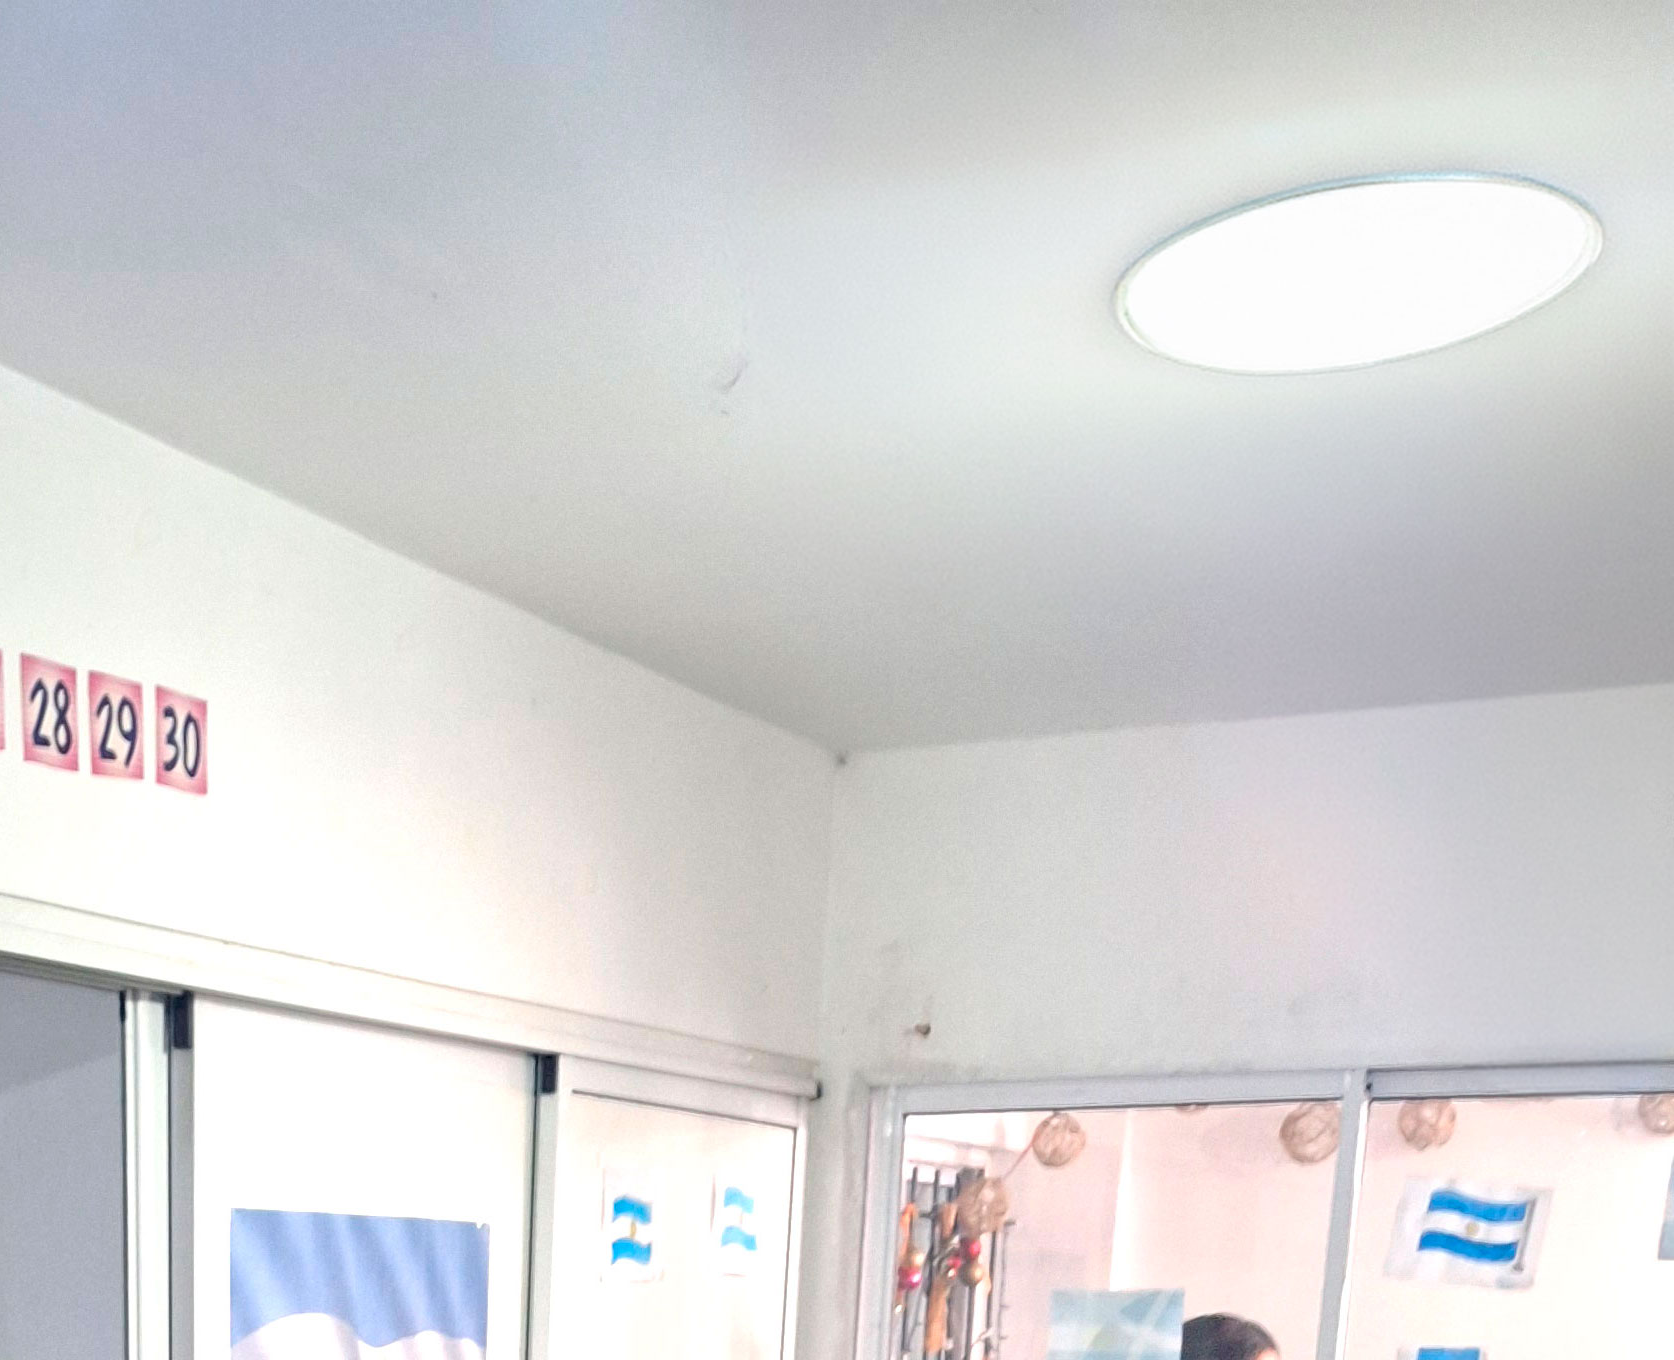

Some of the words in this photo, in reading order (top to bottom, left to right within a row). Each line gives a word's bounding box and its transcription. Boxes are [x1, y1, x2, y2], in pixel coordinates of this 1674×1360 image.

[30, 679, 72, 755] 28
[96, 695, 137, 766] 29
[163, 707, 200, 778] 30
